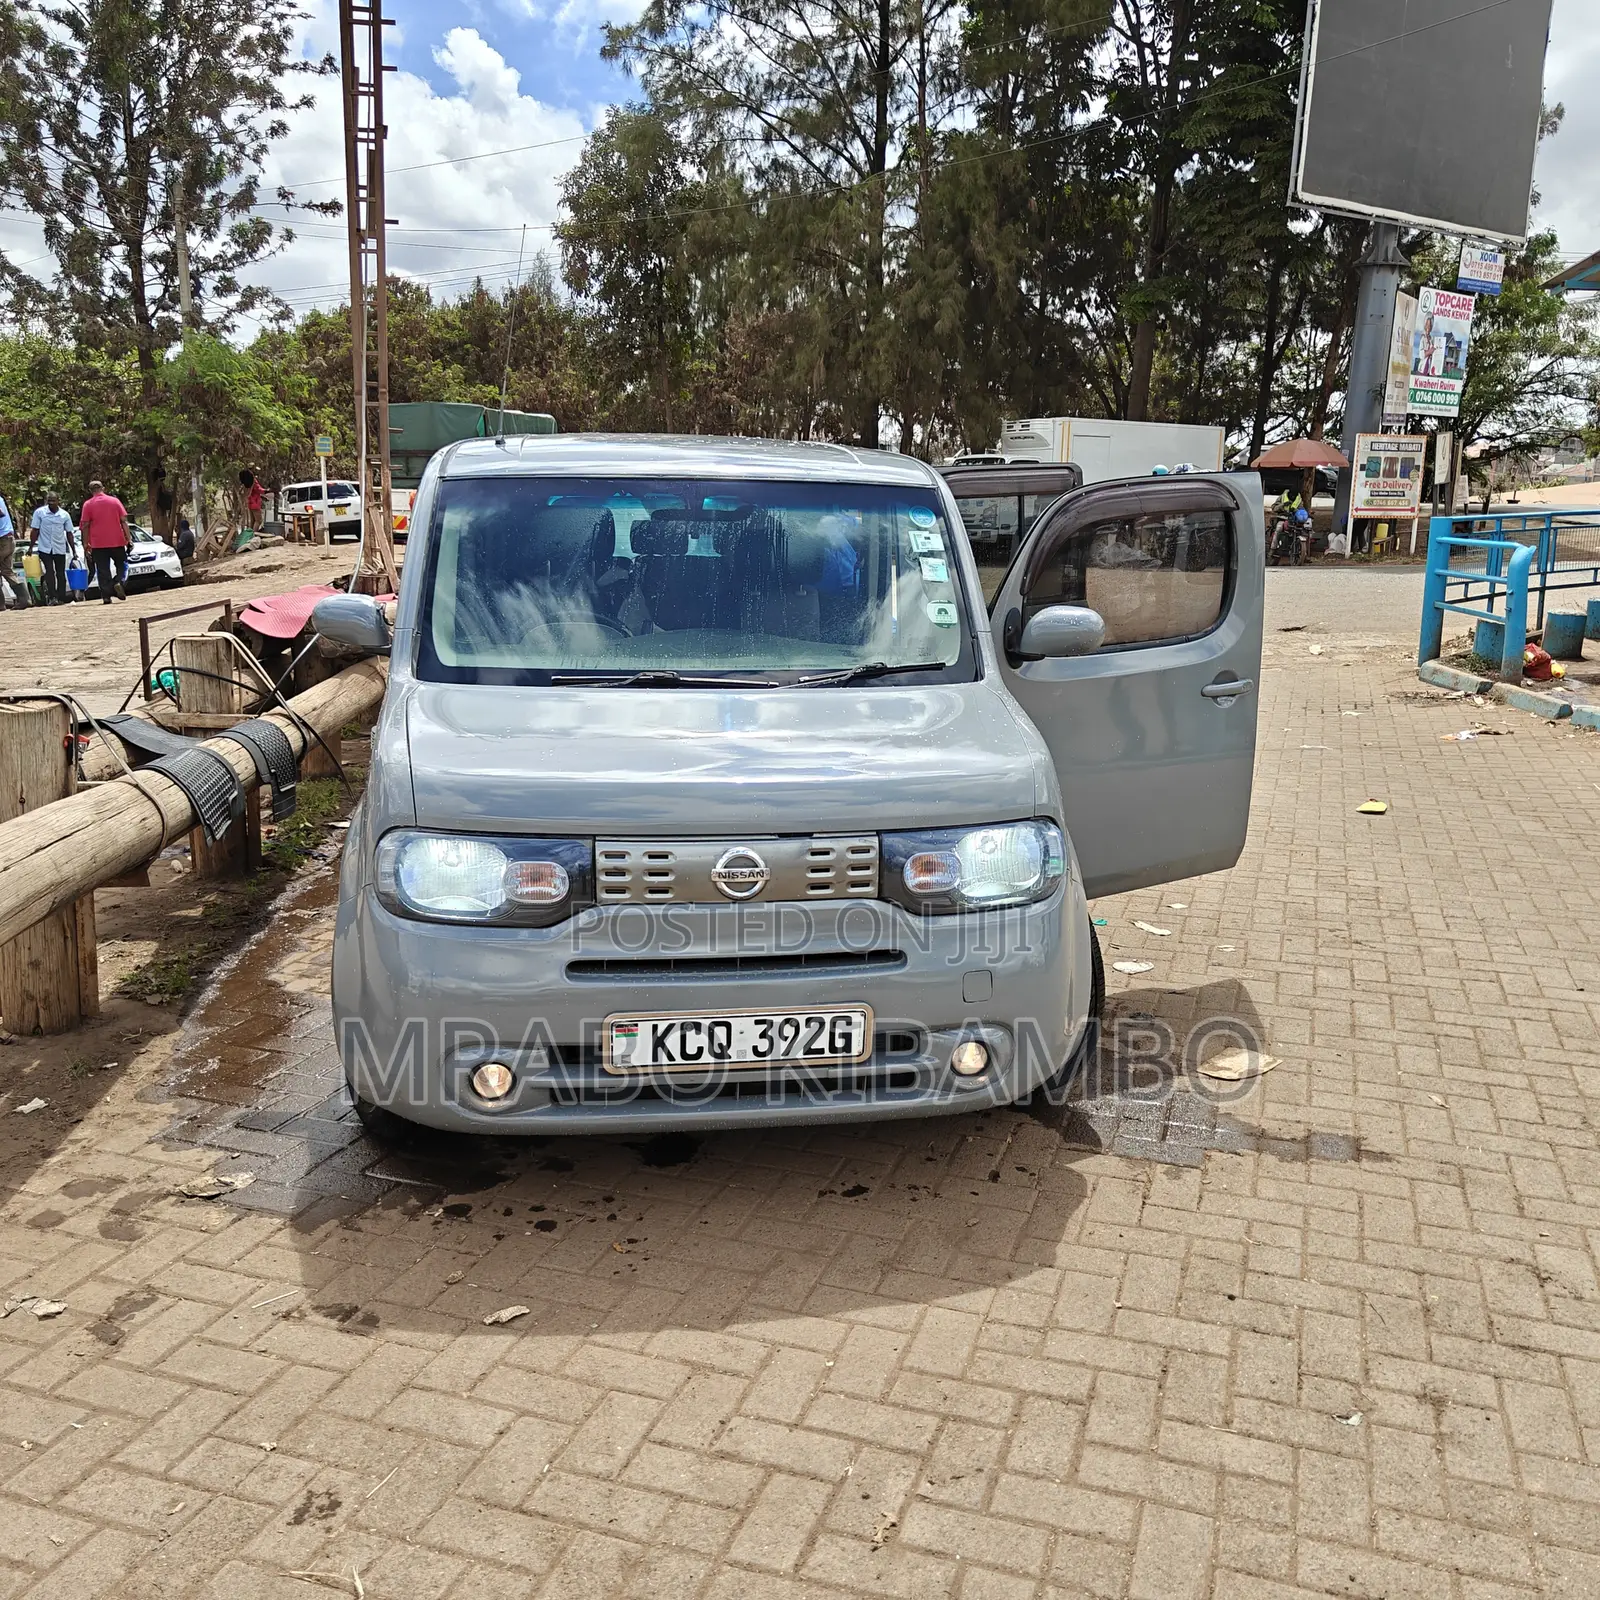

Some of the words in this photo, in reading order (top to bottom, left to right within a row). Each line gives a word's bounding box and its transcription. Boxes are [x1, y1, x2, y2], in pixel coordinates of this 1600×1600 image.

[1480, 251, 1498, 263] XOOM
[1435, 292, 1473, 312] TOPCARE
[1432, 306, 1451, 318] LANDS
[1451, 310, 1470, 321] KENYA
[1414, 378, 1439, 390] Kwaheri
[1440, 380, 1456, 391] Ruiru
[1416, 391, 1432, 402] 0746
[1432, 392, 1446, 404] 000
[1446, 394, 1458, 405] 999
[1372, 442, 1398, 450] HERITAGE
[1399, 444, 1422, 452] MABATI
[1364, 481, 1380, 489] Free
[1382, 481, 1413, 490] Delivery
[718, 870, 765, 879] NISSAN
[651, 1020, 733, 1062] KCQ
[751, 1015, 853, 1058] 392G
